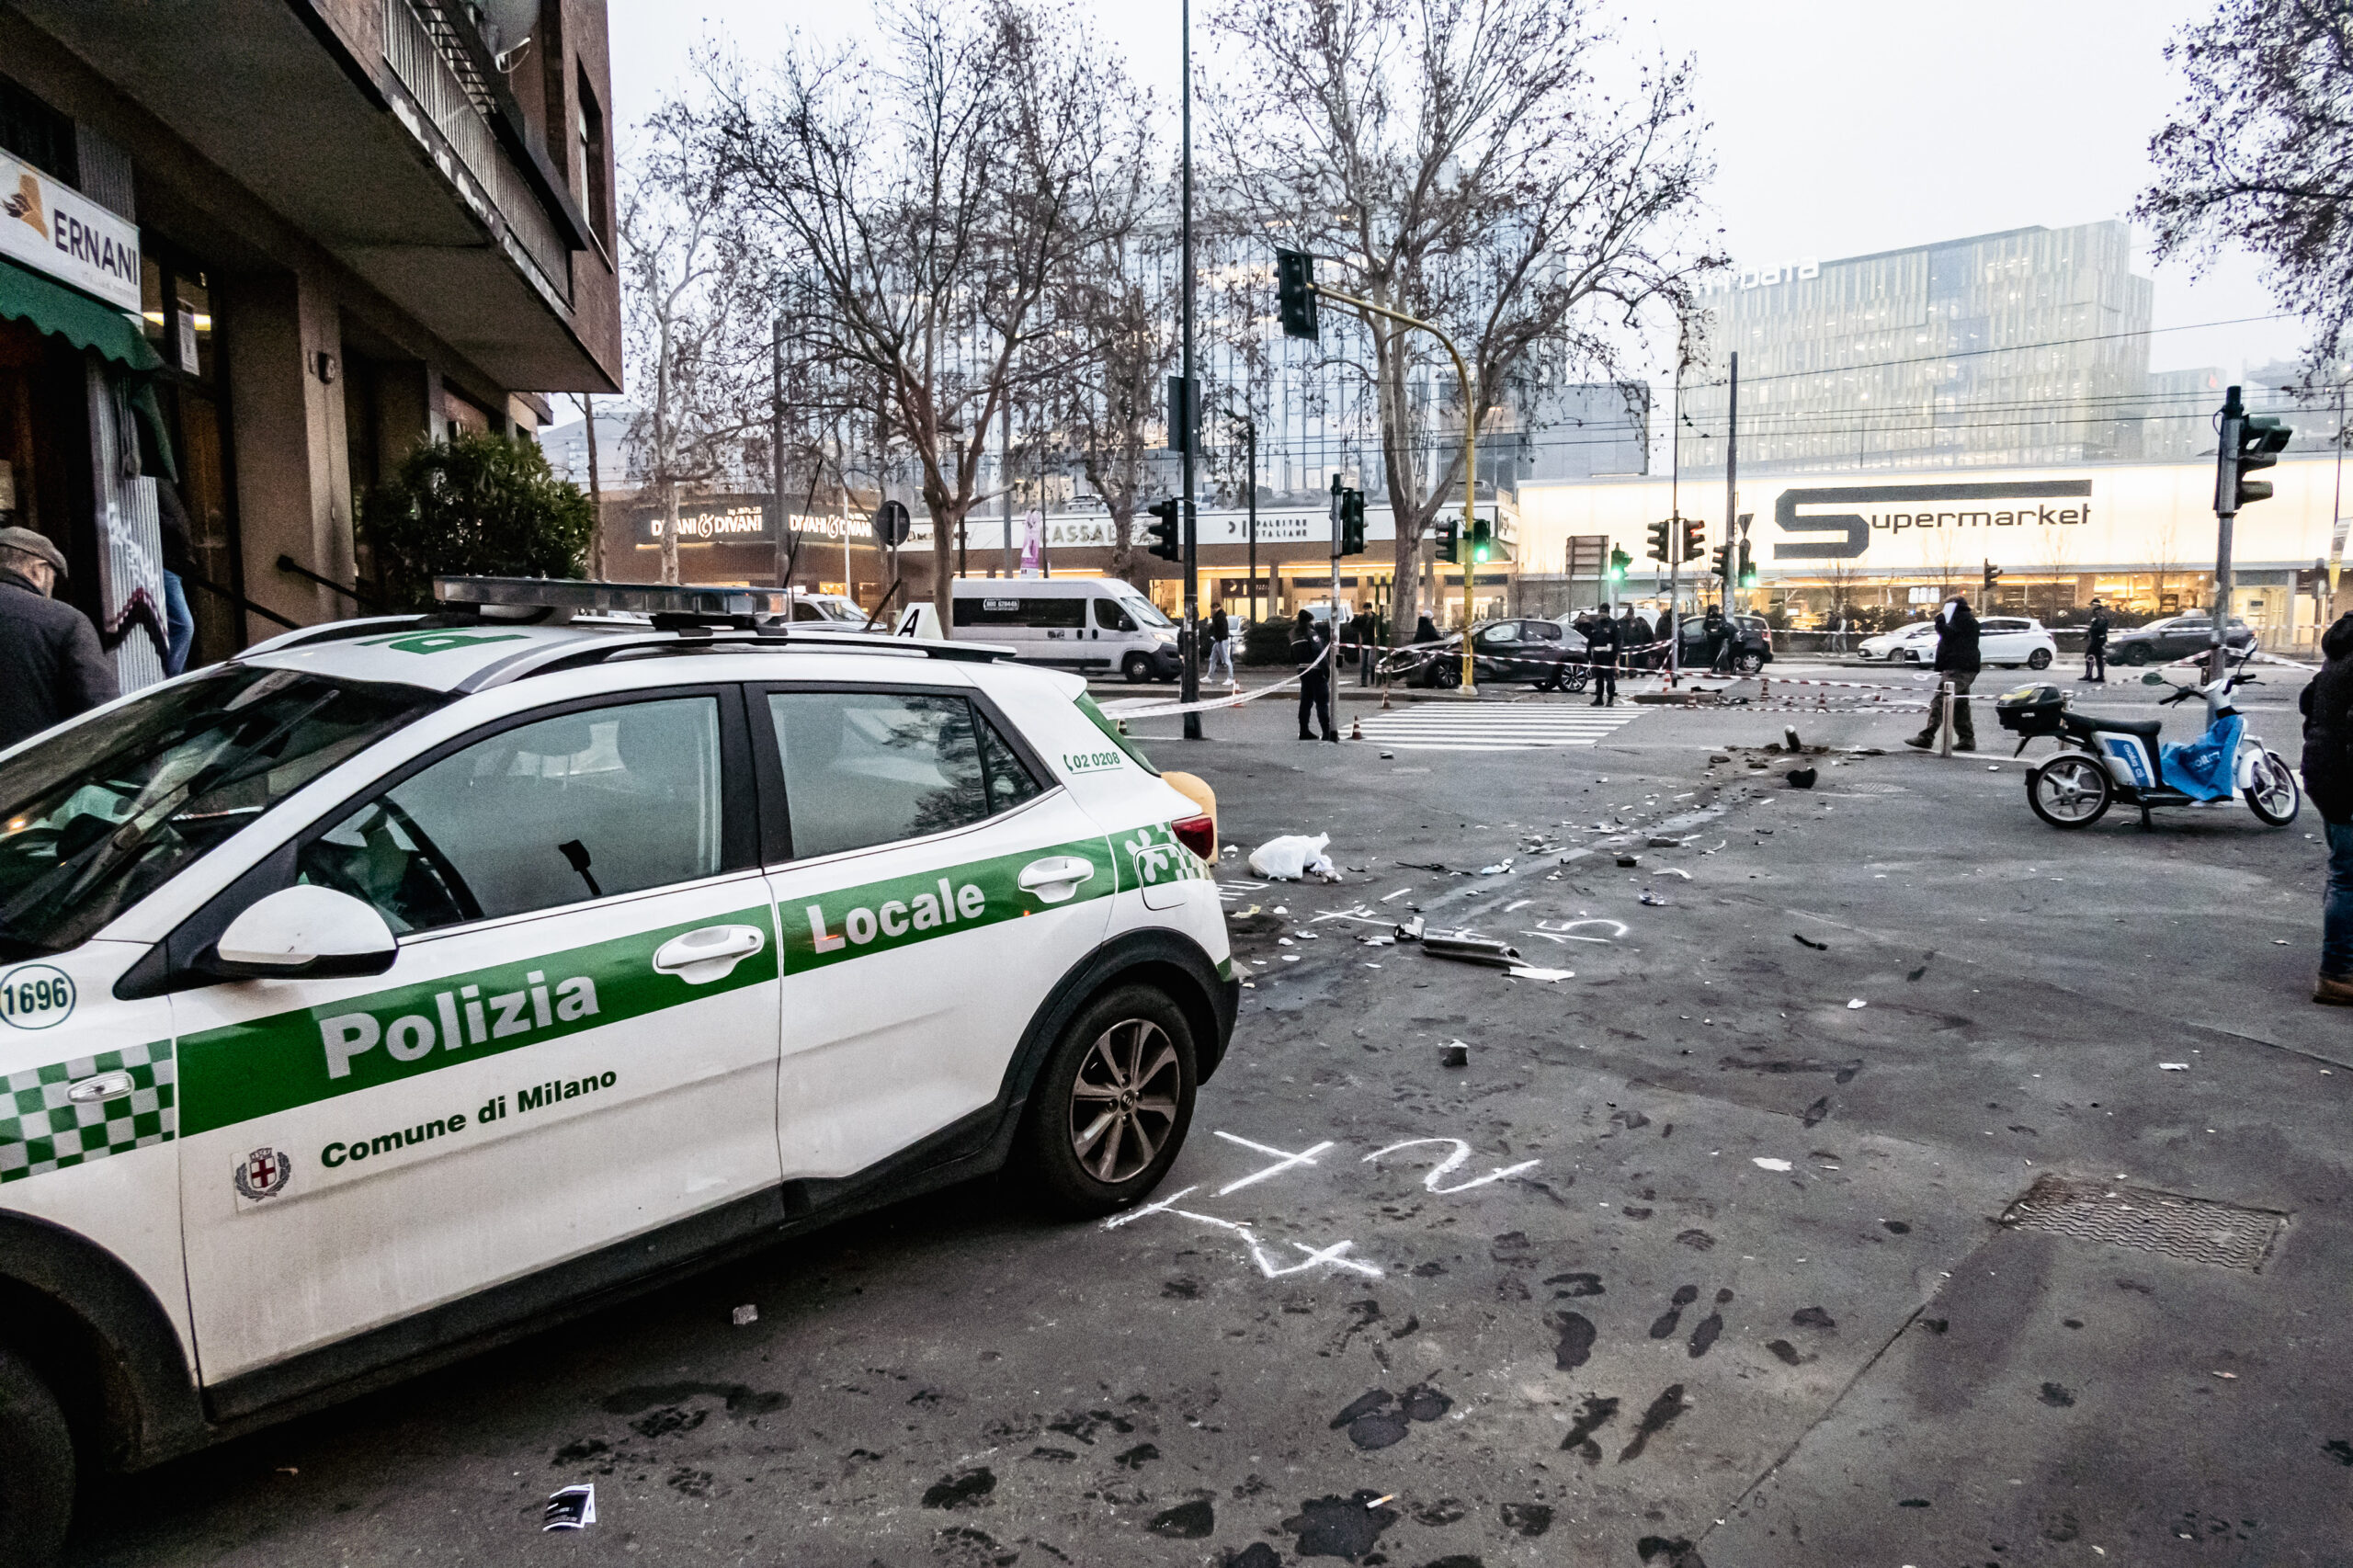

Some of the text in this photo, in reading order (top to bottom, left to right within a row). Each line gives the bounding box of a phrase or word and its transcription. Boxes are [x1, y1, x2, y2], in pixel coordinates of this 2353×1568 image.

[53, 208, 138, 286] ERNANI
[1256, 518, 1307, 528] PALESTRE
[1256, 528, 1307, 537] ITALIANE
[1774, 479, 2092, 560] Supermarket
[897, 608, 920, 638] A
[1073, 752, 1120, 768] 02 0208
[805, 877, 986, 955] Locale
[3, 977, 69, 1016] 1696
[318, 970, 600, 1080] Polizia
[321, 1070, 618, 1168] Comune di Milano
